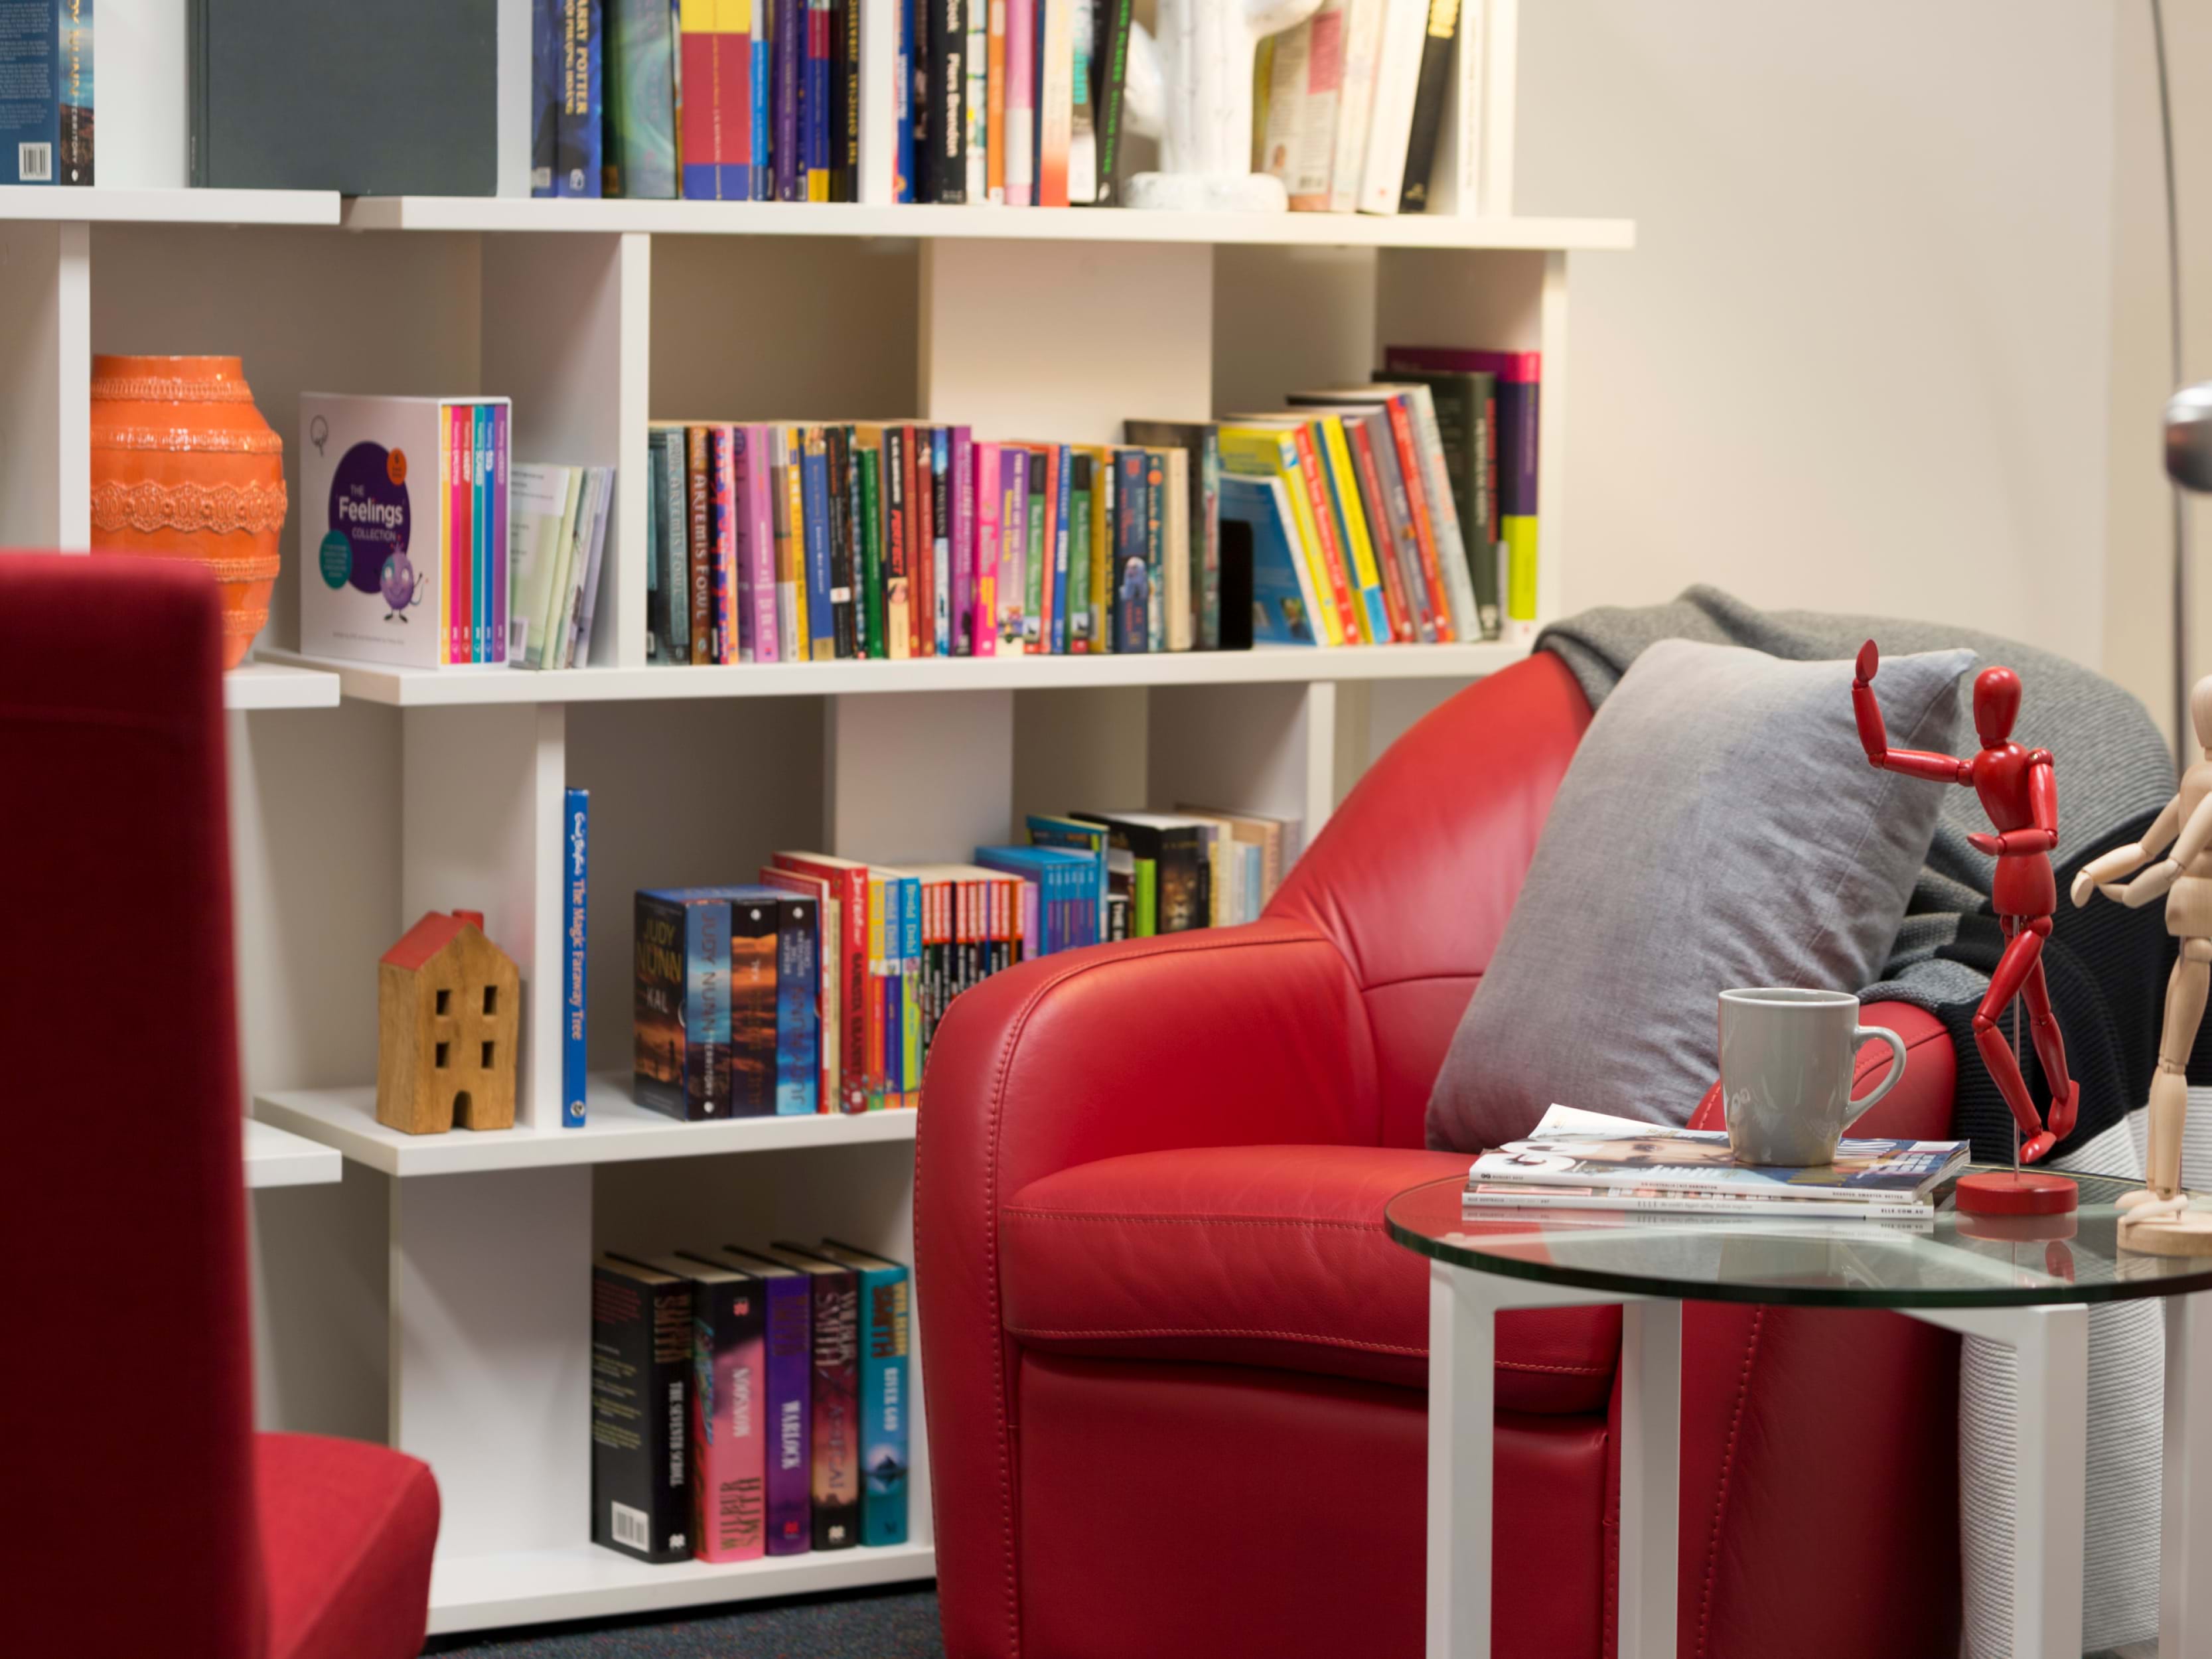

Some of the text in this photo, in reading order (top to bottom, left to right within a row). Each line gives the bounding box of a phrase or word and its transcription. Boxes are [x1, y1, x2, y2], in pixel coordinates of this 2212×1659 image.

[577, 0, 589, 115] ARRY POTTER
[849, 74, 858, 136] OFFICIAL
[339, 496, 404, 528] Feelings
[351, 484, 364, 496] THE
[668, 476, 682, 547] ARTEMIS
[693, 474, 707, 558] ARTEMIS
[352, 528, 396, 542] COLLECTION
[892, 510, 903, 575] PERFECT
[672, 551, 685, 595] FOWL
[697, 565, 709, 619] FOWL
[645, 918, 676, 945] JUDY
[907, 885, 916, 953] Roald Dahl
[569, 879, 585, 1040] The Magic Faraway Tree
[636, 941, 682, 984] NUNN
[700, 912, 717, 1033] JUDY NUNN
[647, 987, 669, 1014] KAL
[703, 1031, 714, 1096] TERRITORY
[815, 1292, 840, 1366] SMITH
[838, 1291, 857, 1362] WILBUR
[733, 1368, 751, 1438] MONSOON
[884, 1367, 899, 1431] RIVER GOD
[670, 1382, 684, 1488] THE SEVENTH SCROLL
[781, 1399, 801, 1470] WARLOCK
[829, 1404, 844, 1489] ASSEGAI
